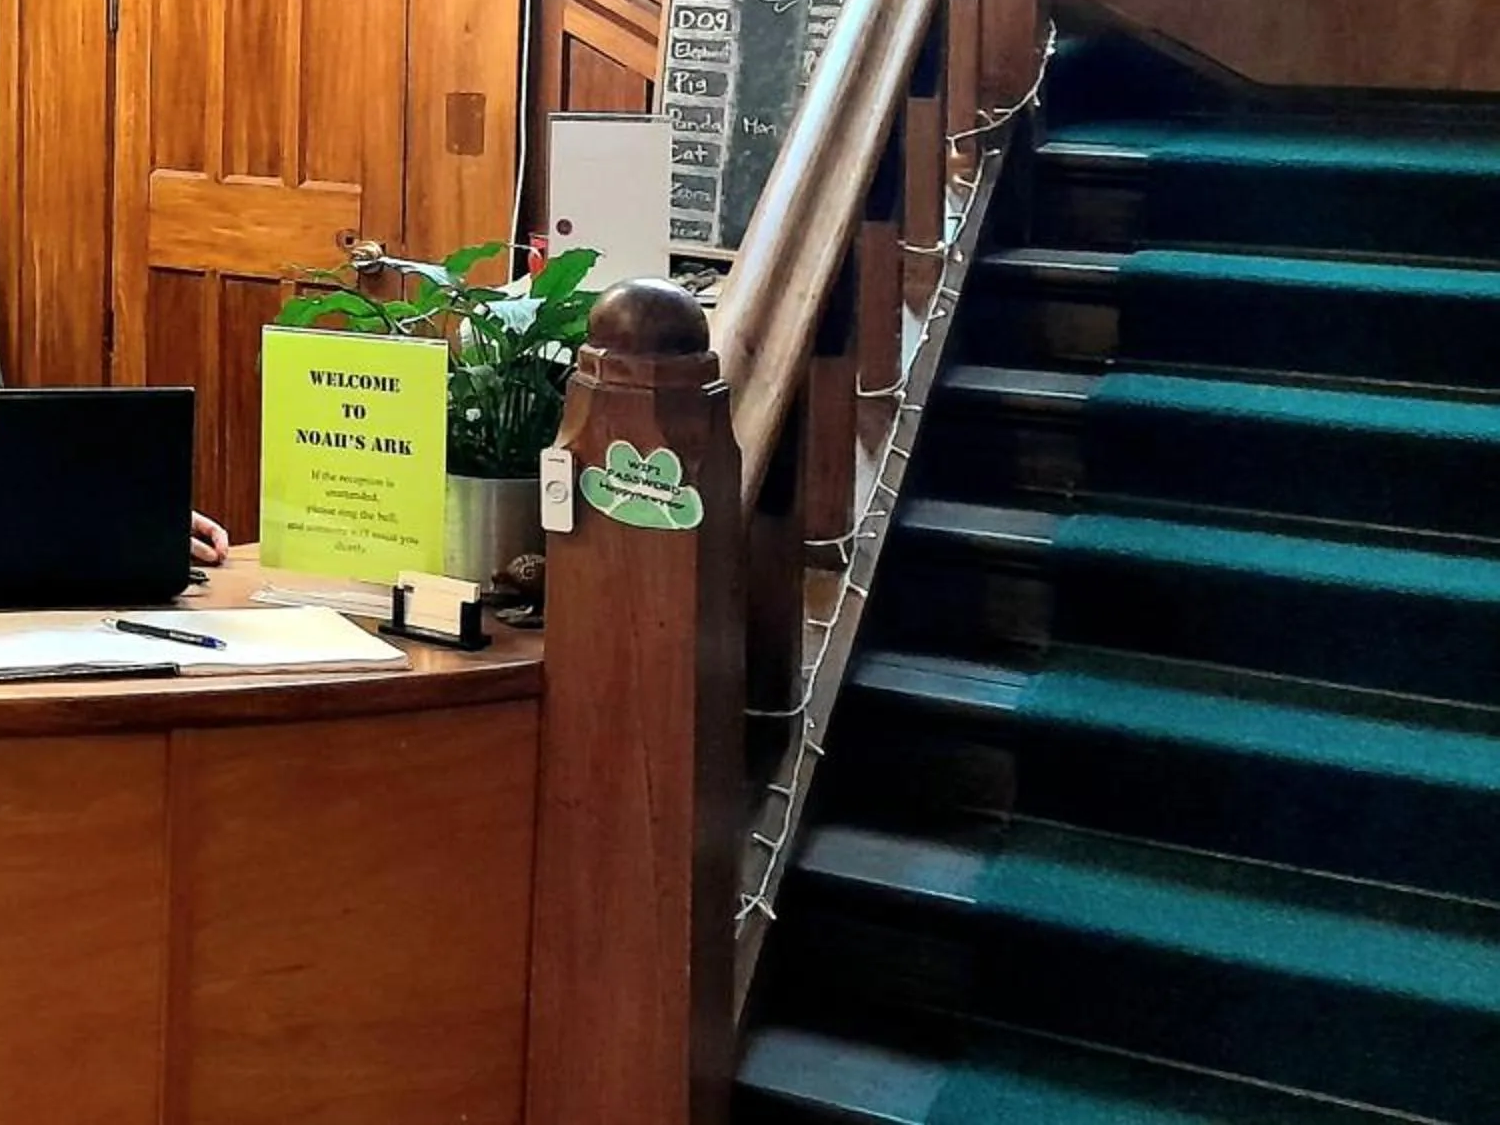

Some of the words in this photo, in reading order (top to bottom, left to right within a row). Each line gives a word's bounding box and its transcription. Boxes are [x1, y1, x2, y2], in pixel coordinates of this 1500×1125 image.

[672, 71, 708, 94] Pig
[671, 143, 709, 163] Cat
[309, 369, 400, 394] WELCOME
[341, 403, 367, 420] TO
[295, 428, 366, 451] NOAH'S
[371, 438, 414, 456] ARK
